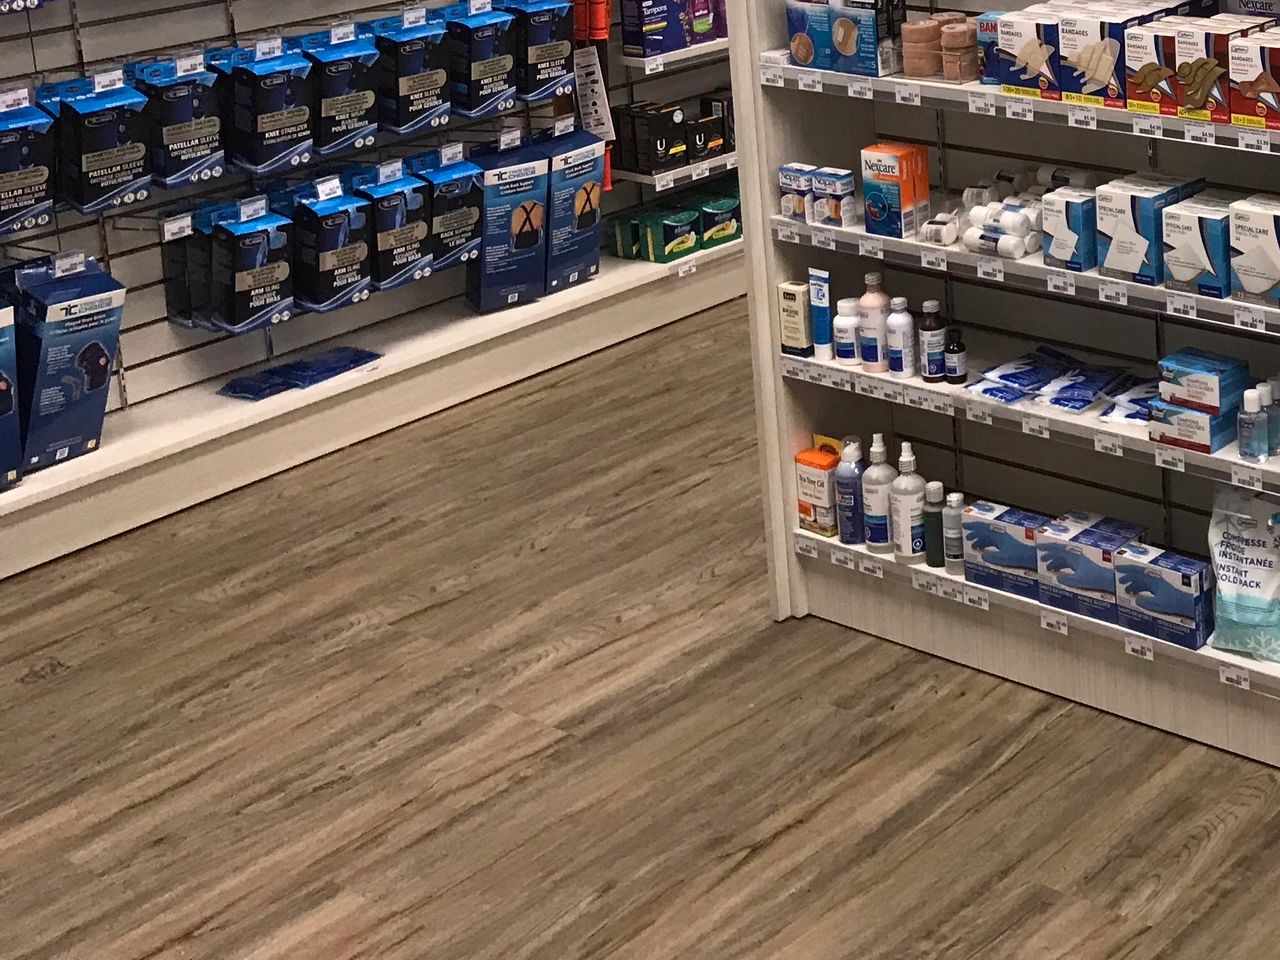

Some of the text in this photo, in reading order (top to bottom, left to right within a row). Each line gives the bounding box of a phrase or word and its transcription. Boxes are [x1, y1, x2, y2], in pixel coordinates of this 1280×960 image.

[642, 4, 668, 16] Tampons
[1001, 29, 1022, 38] BANDAGES
[1061, 28, 1088, 37] BANDAGES
[550, 58, 565, 67] SLEEVE
[480, 77, 493, 85] KNEE
[424, 88, 441, 97] SLEEVE
[409, 103, 423, 112] POUR
[1233, 116, 1246, 124] 10+2
[265, 124, 308, 139] KNEE STABILIZER
[169, 134, 220, 151] PATELLAR SLEEVE
[89, 160, 145, 178] PATELLAR SLEEVE
[864, 159, 896, 175] Nexcare
[24, 183, 47, 195] SLEEVE
[1235, 224, 1254, 234] SPECIAL
[334, 267, 346, 275] ARM
[250, 287, 264, 296] ARM
[1222, 531, 1268, 548] COMPRESSE
[1220, 540, 1246, 555] FROIDE
[1218, 550, 1274, 569] INSTANTANÉE
[1217, 563, 1249, 578] INSTANT
[1217, 572, 1262, 589] COLD PACK
